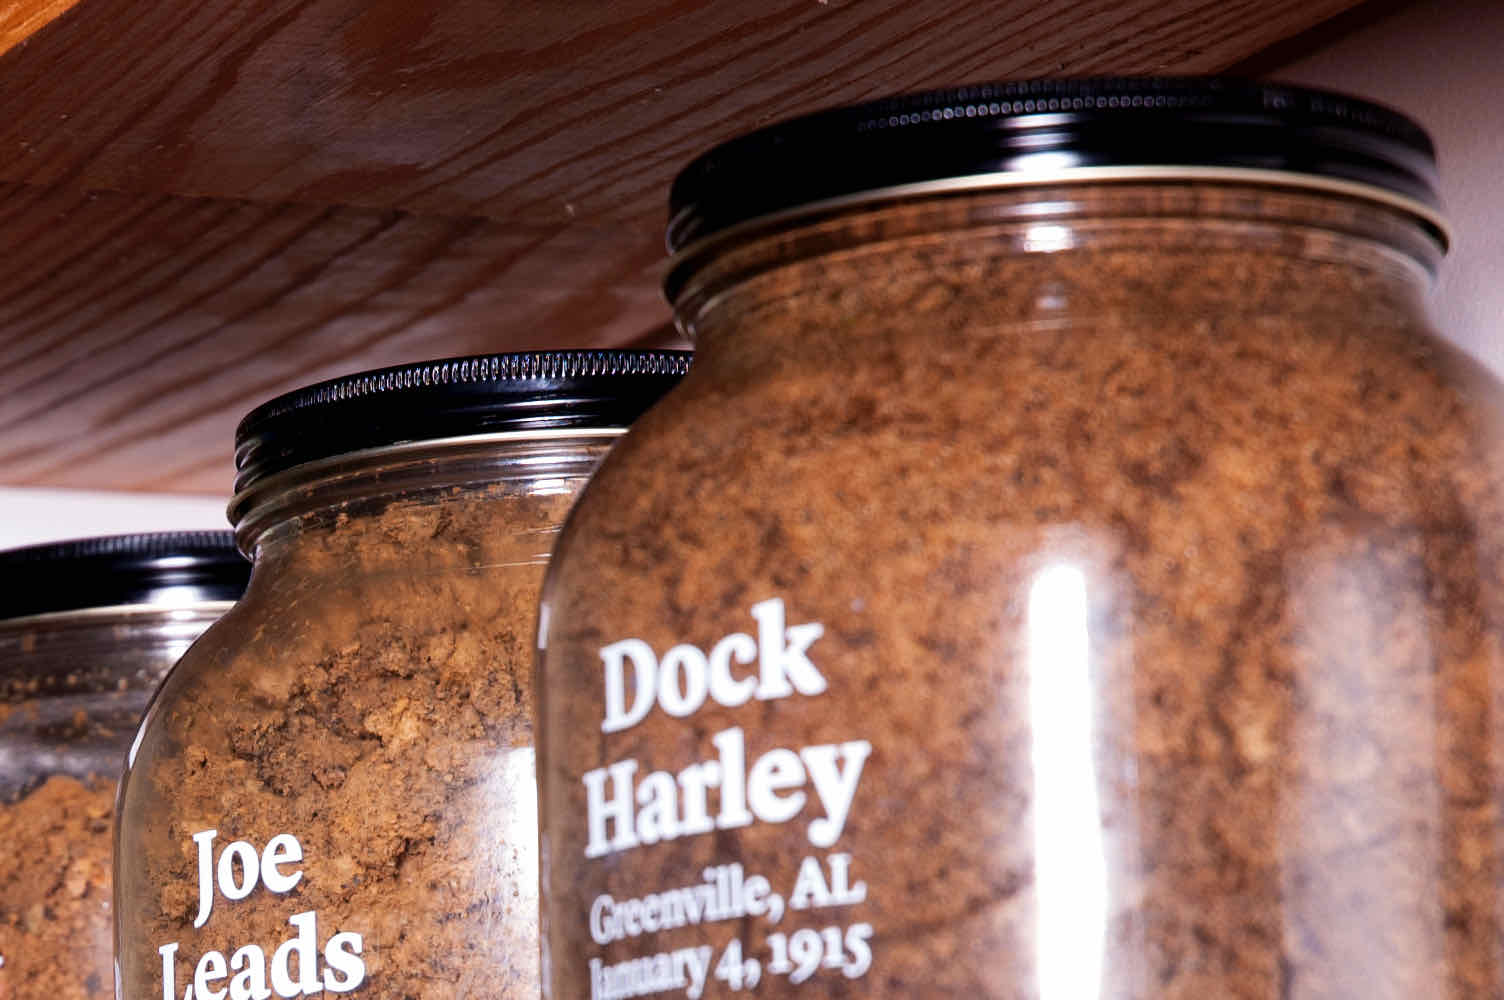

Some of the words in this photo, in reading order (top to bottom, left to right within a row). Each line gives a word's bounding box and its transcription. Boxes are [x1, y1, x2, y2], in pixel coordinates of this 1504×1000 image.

[598, 596, 828, 733] Dock
[582, 726, 872, 858] Harley
[192, 829, 303, 929] Joe
[589, 862, 785, 944] Greenville,
[788, 852, 868, 909] AL
[714, 937, 762, 990] 4,
[765, 922, 874, 983] 1915
